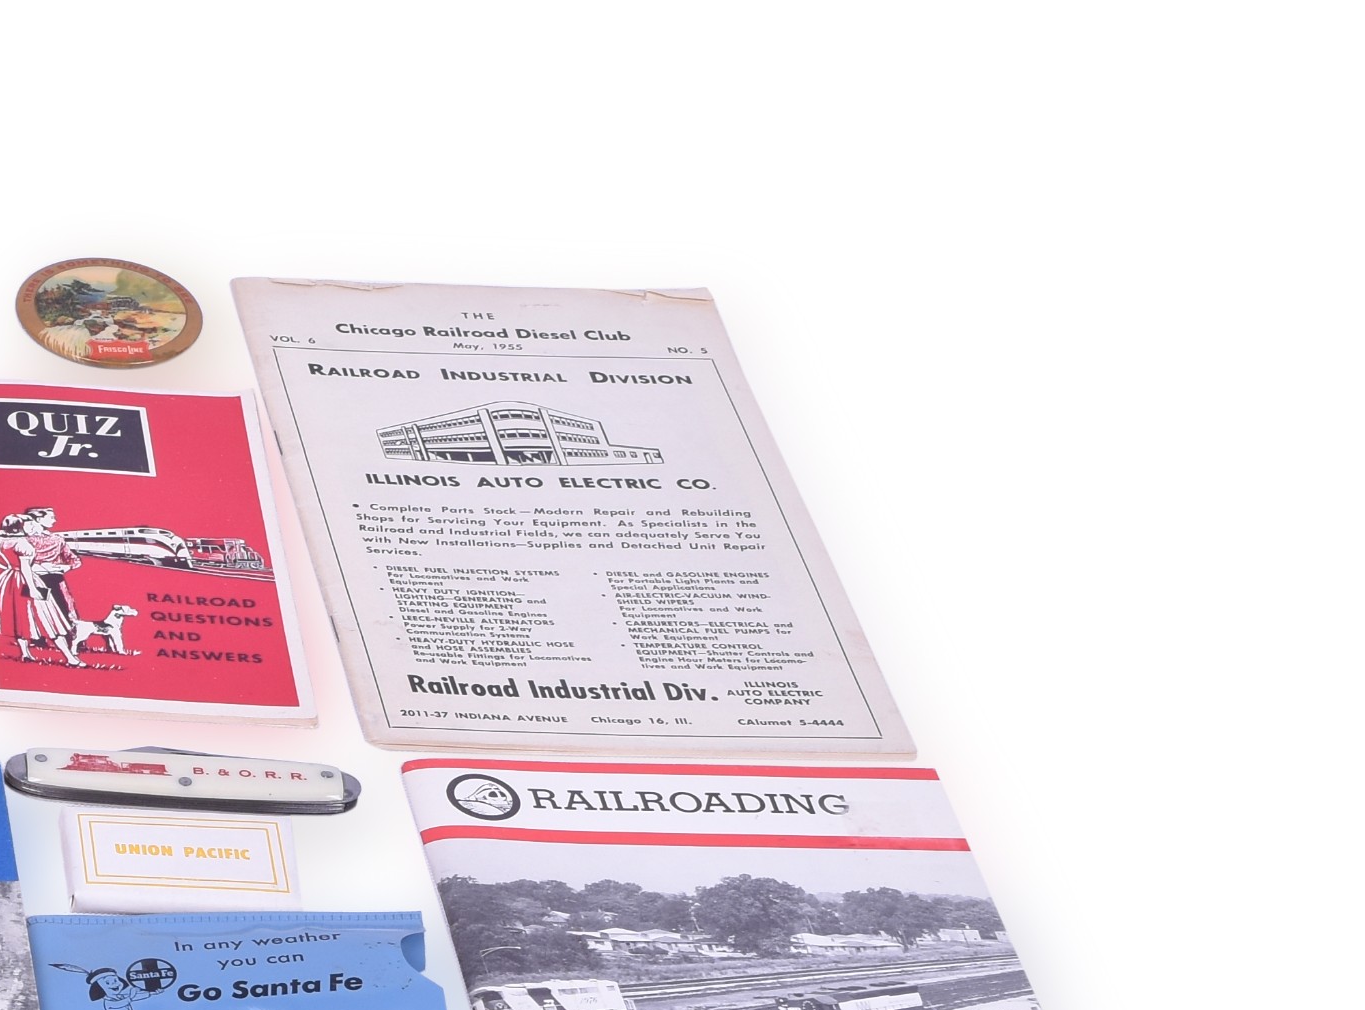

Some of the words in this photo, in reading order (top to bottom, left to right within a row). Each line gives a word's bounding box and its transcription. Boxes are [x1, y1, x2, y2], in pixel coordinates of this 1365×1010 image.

[335, 324, 417, 337] Chicago
[422, 326, 509, 338] Railroad
[514, 329, 577, 339] Diesel
[583, 331, 631, 340] Club
[452, 343, 484, 351] May,
[7, 411, 121, 436] QUIZ
[38, 435, 98, 458] Jr.
[365, 474, 461, 487] ILLINOIS
[476, 477, 544, 487] AUTO
[558, 478, 663, 489] ELECTRIC
[676, 479, 717, 489] CO.
[147, 593, 256, 608] RAILROAD
[151, 611, 273, 627] QUESTIONS
[153, 630, 202, 641] AND
[157, 648, 263, 663] ANSWERS
[407, 675, 519, 697] Railroad
[528, 679, 655, 700] Industrial
[663, 683, 718, 701] Div.
[192, 767, 210, 775] B.
[264, 771, 282, 779] R.
[527, 789, 849, 815] RAILROADING
[114, 844, 174, 856] UNION
[183, 847, 251, 860] PACIFIC
[174, 942, 194, 951] In
[203, 941, 243, 950] any
[251, 933, 341, 945] weather
[216, 958, 257, 970] you
[266, 954, 305, 963] can
[178, 984, 221, 1001] Go
[232, 979, 320, 999] Santa
[330, 973, 362, 991] Fe
